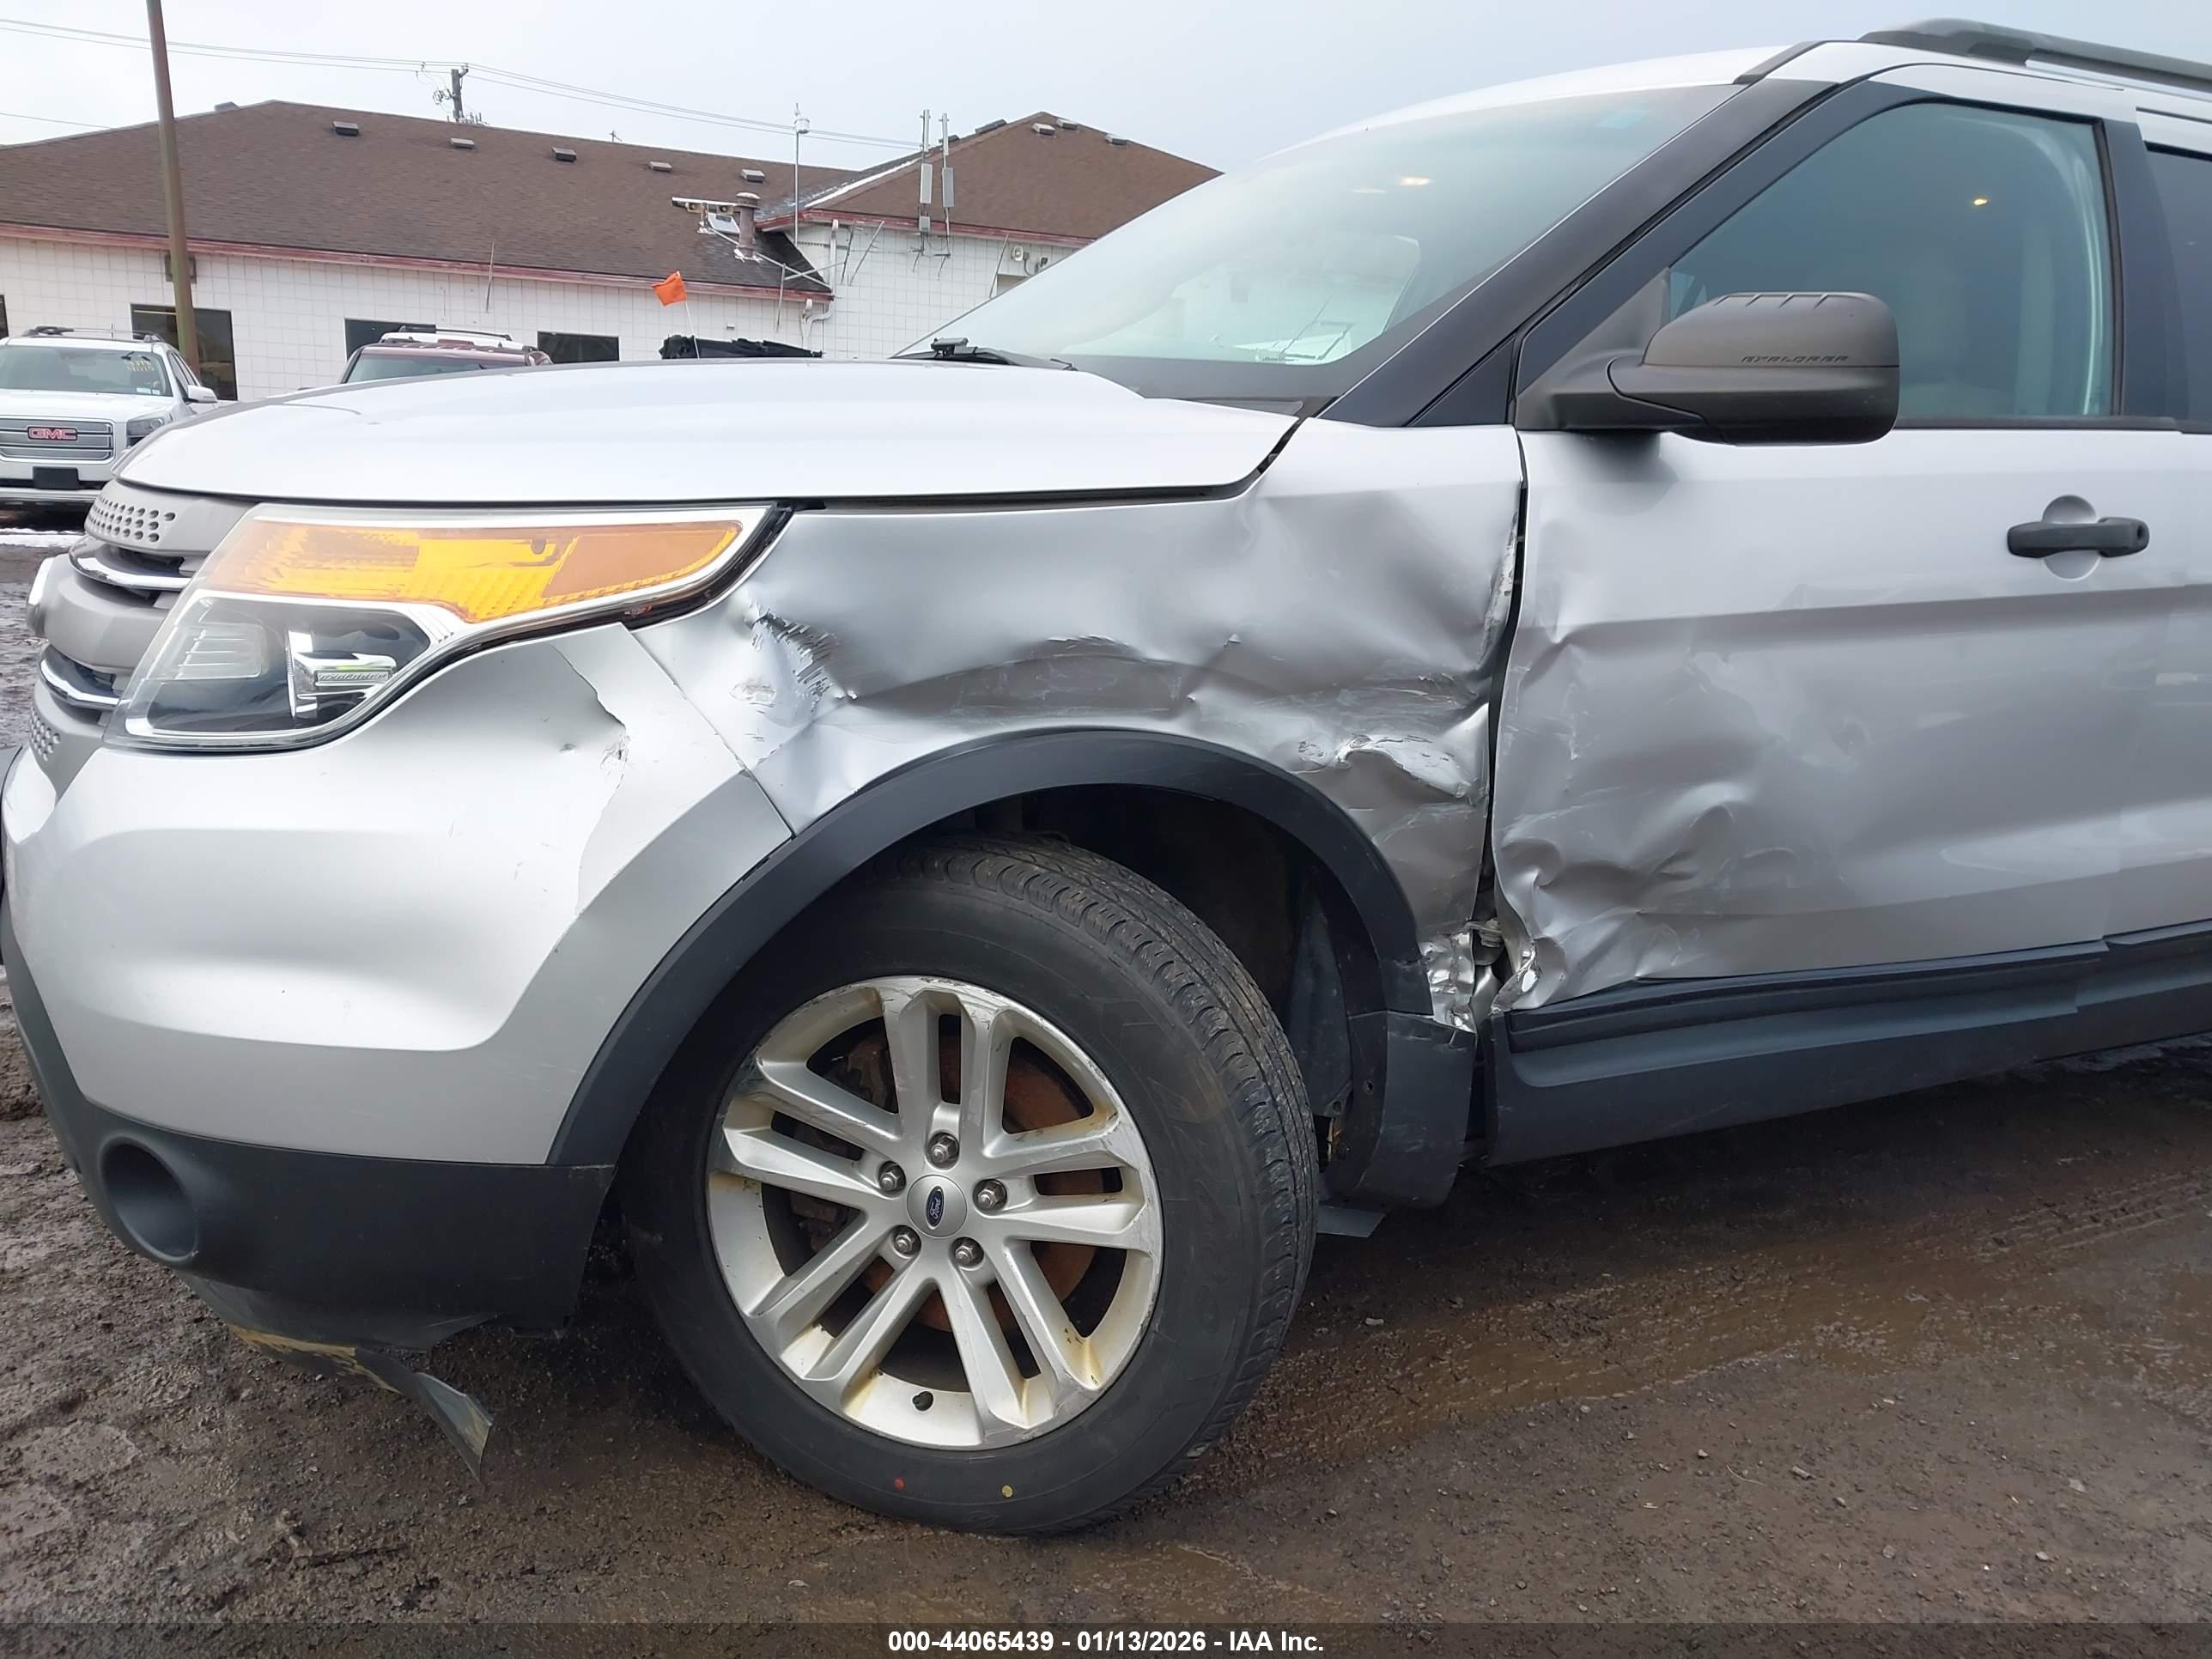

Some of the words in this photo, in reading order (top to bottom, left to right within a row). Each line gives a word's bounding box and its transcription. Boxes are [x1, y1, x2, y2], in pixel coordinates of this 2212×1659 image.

[1741, 355, 1850, 364] EXPLORER
[28, 427, 76, 440] GMC
[929, 1196, 942, 1219] Ford
